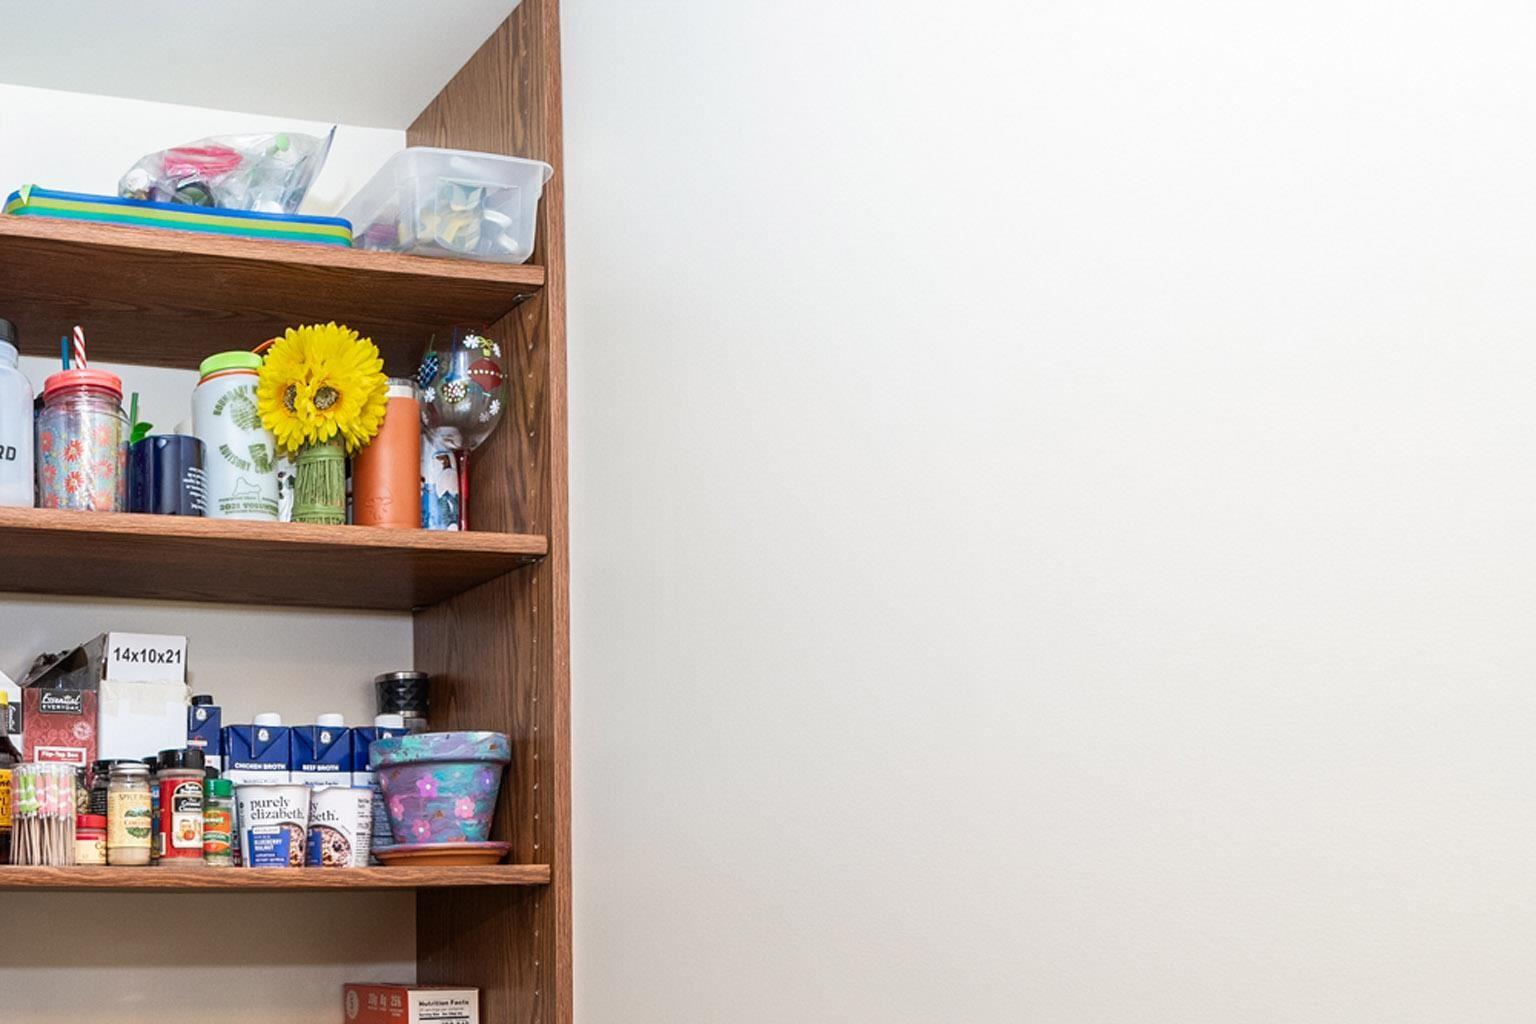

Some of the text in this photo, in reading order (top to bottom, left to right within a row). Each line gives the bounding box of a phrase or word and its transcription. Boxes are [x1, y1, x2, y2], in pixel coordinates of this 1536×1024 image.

[113, 647, 182, 665] 14x10x21
[42, 692, 81, 705] Essential
[250, 796, 291, 812] purely
